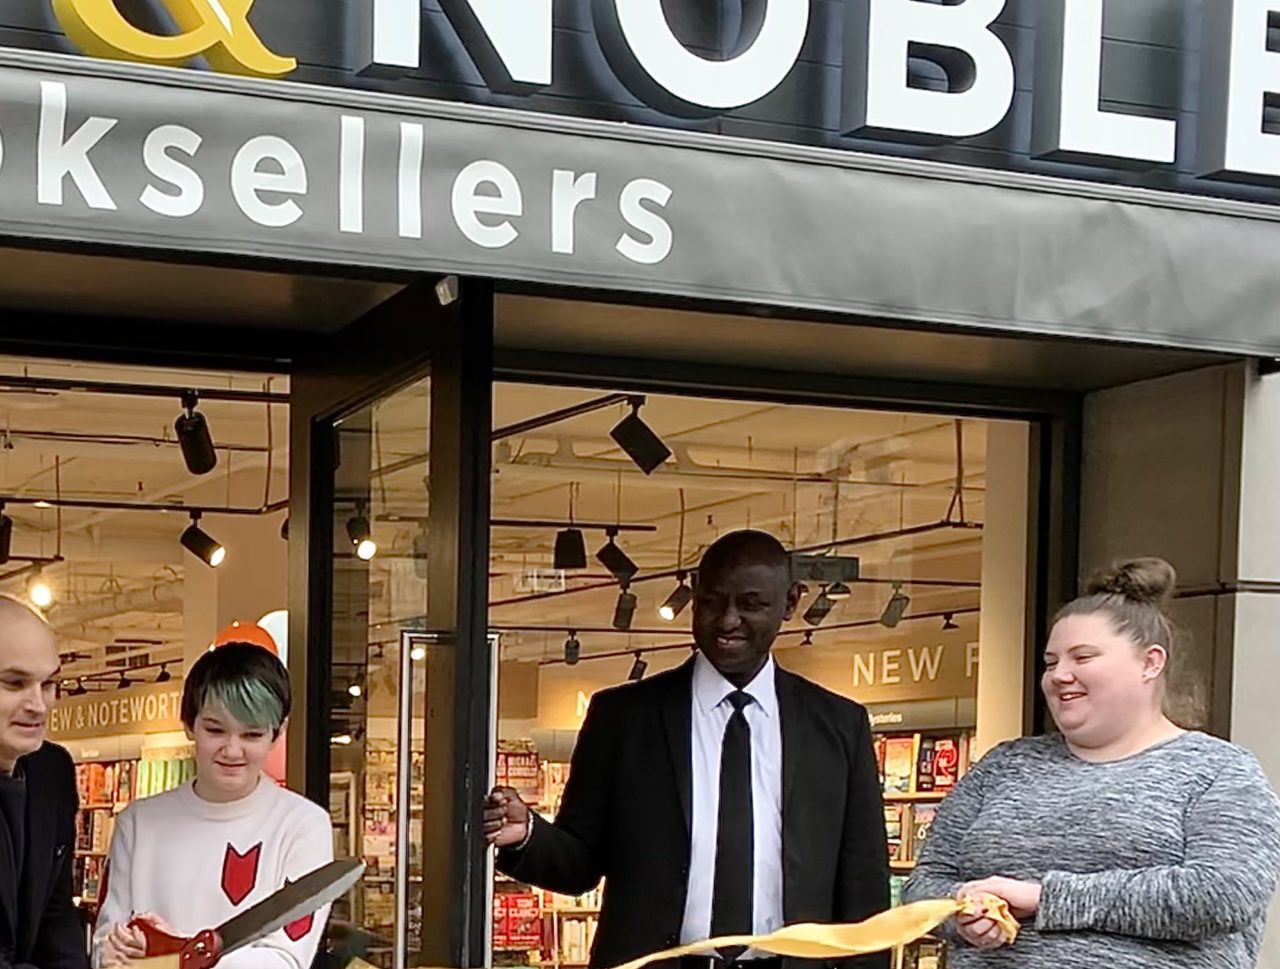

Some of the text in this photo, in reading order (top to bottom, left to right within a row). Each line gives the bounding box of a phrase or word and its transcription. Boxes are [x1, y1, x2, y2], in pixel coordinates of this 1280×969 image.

[853, 645, 945, 687] NEW
[47, 708, 72, 731] EW
[76, 705, 85, 729] &
